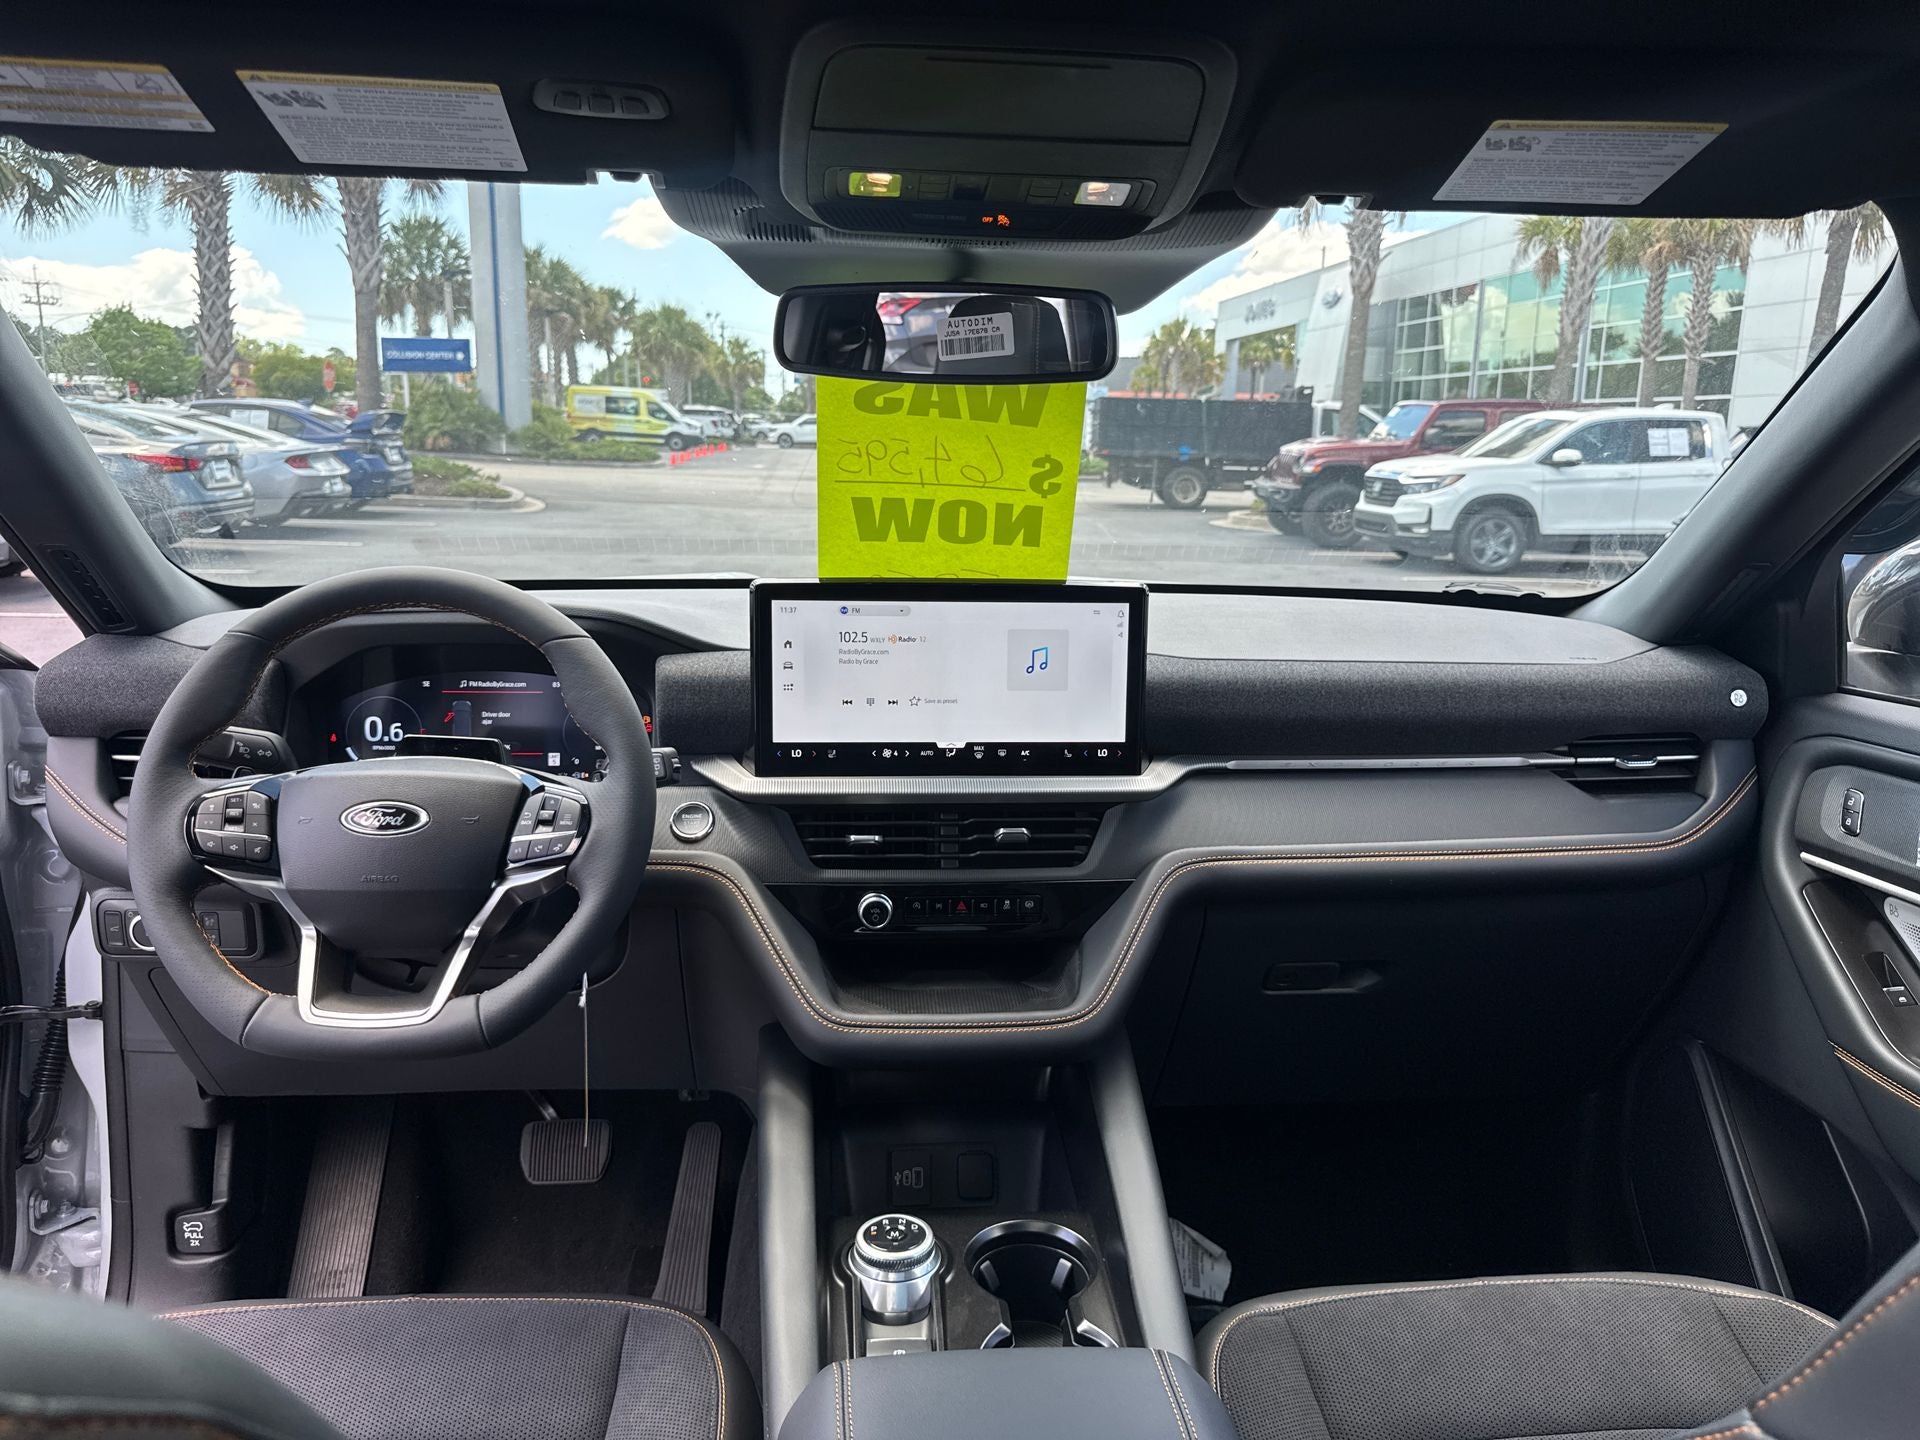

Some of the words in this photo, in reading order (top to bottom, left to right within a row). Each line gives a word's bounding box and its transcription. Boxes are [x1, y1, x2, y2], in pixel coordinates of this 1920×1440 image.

[947, 317, 994, 329] AUTODIM
[386, 351, 424, 360] COLLISION
[425, 351, 454, 360] CENTER
[839, 631, 868, 643] 102.5
[898, 635, 917, 643] Radio
[838, 648, 889, 656] RadioByGrace.com
[364, 716, 404, 742] 0.6
[791, 749, 802, 758] LO
[1097, 749, 1108, 757] LO
[357, 807, 407, 828] Ford
[361, 874, 400, 883] AIRBAG
[189, 1239, 201, 1247] 2X
